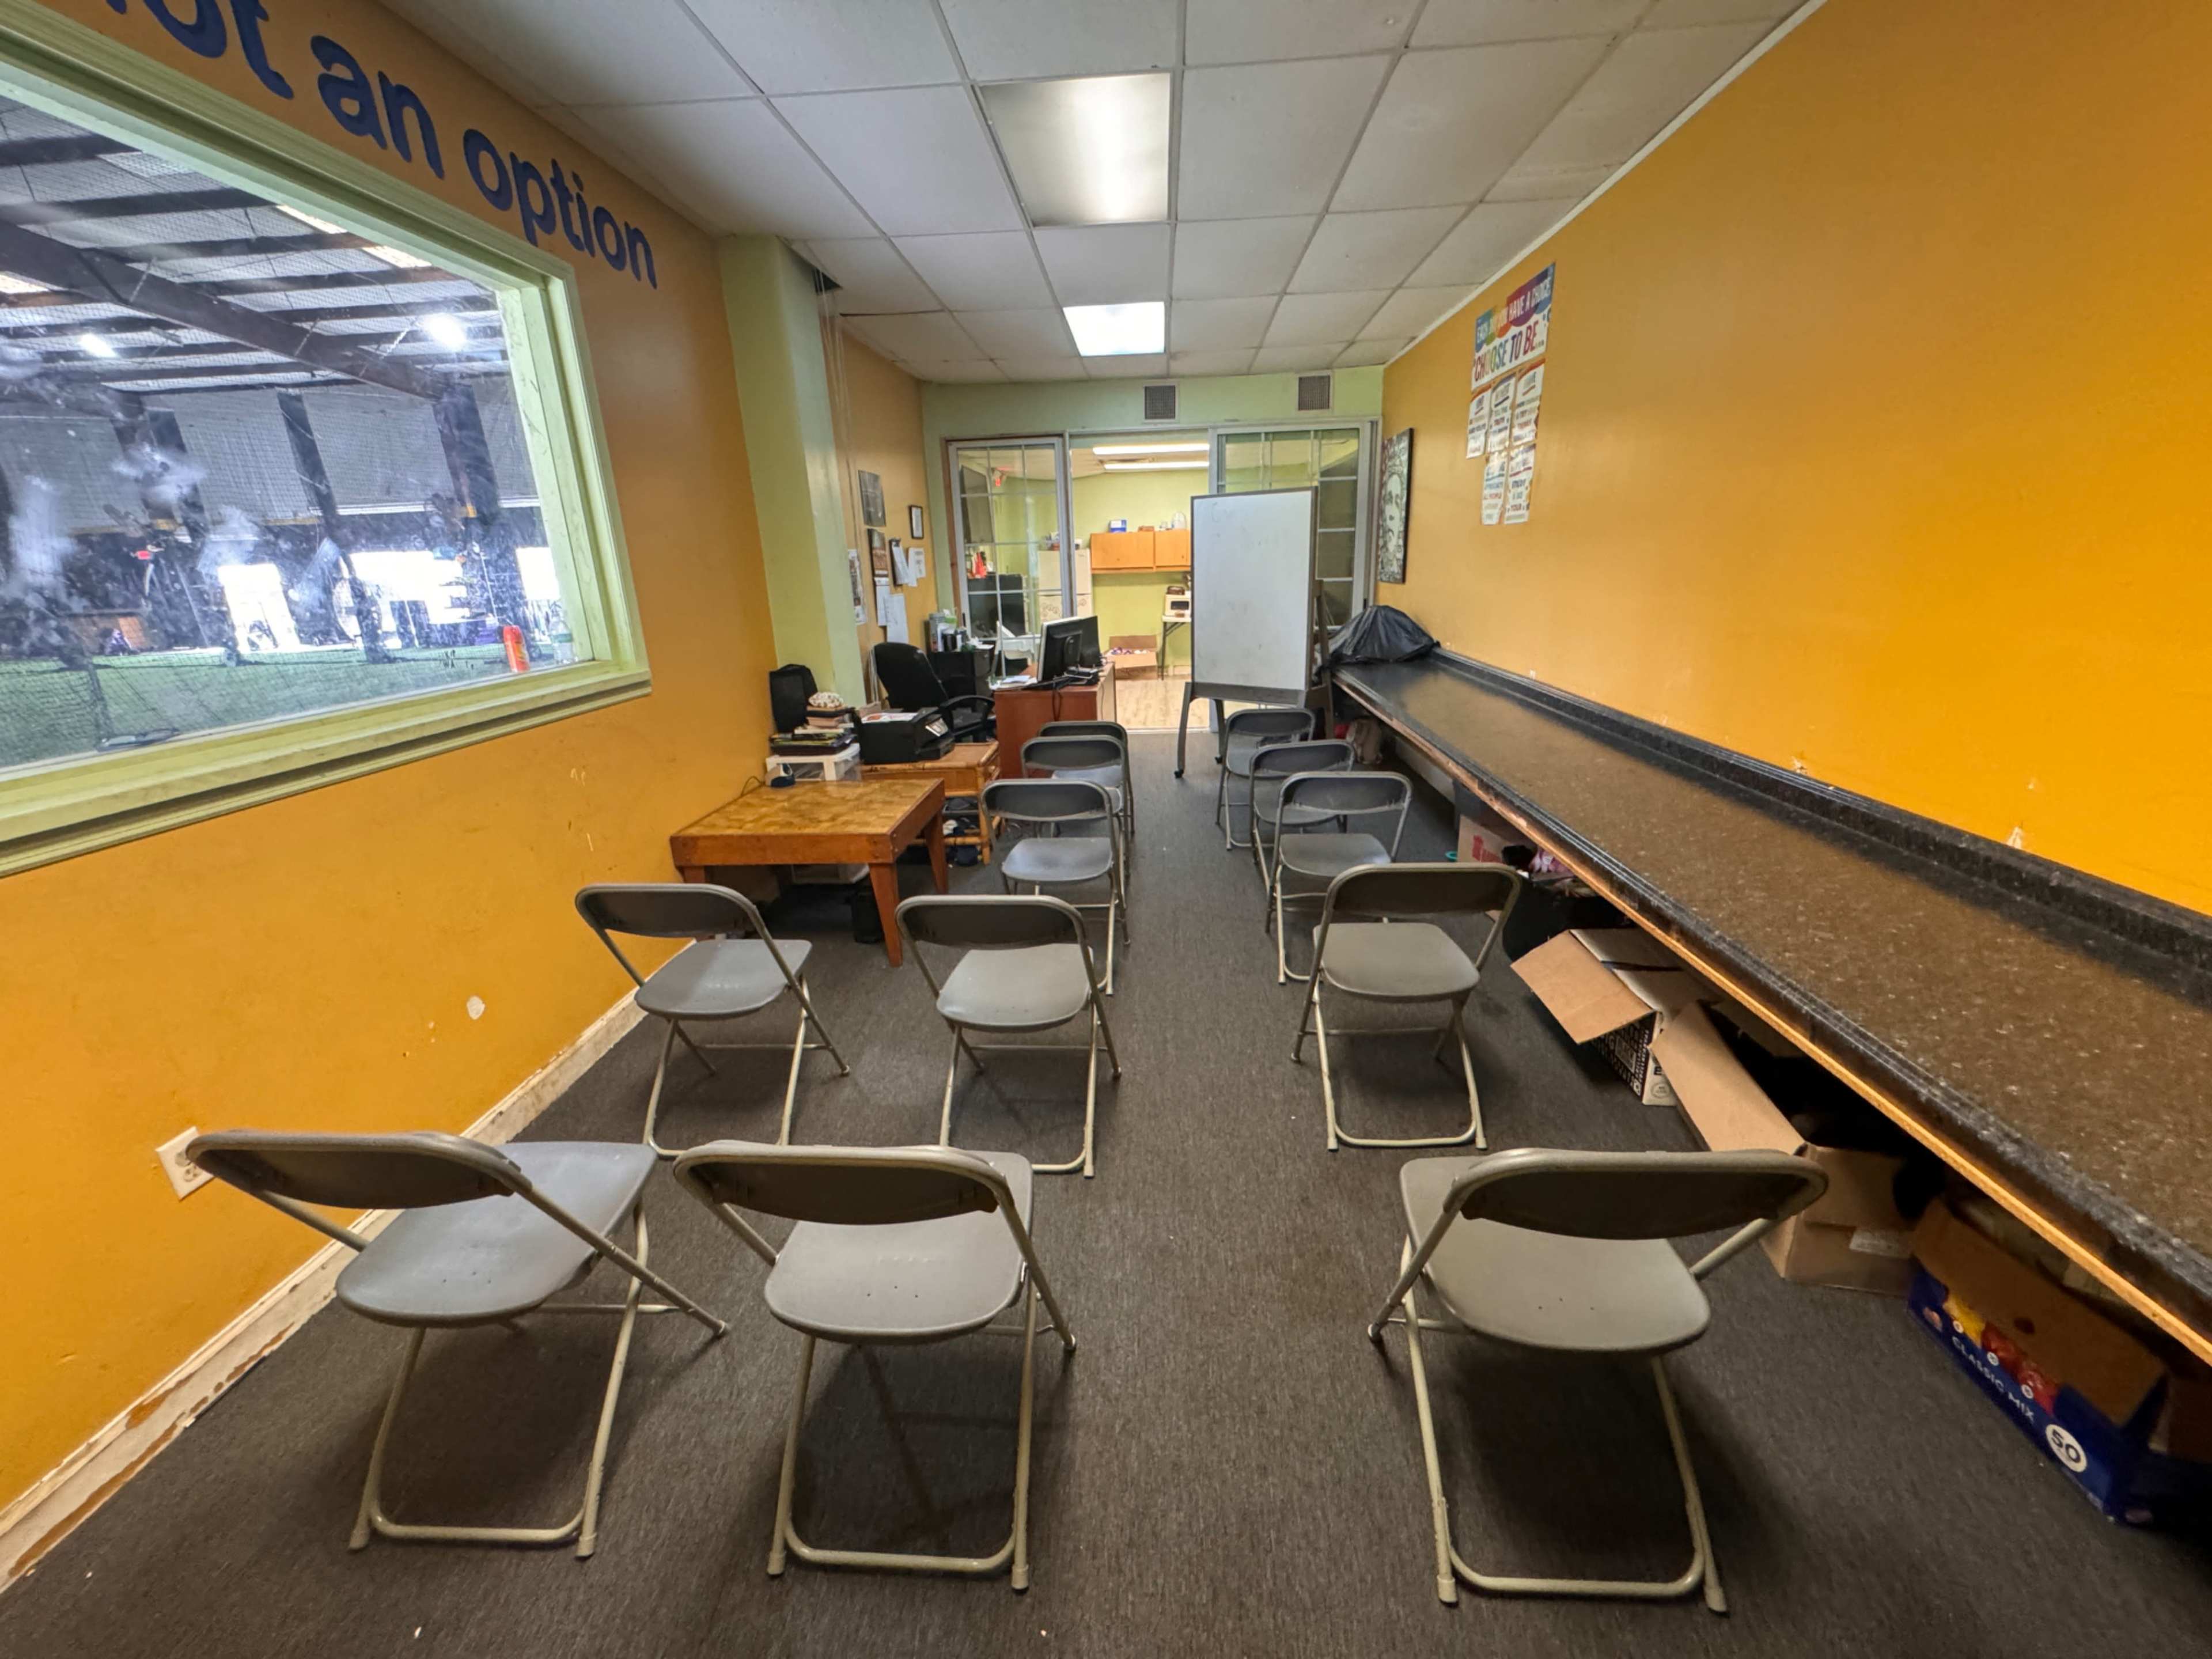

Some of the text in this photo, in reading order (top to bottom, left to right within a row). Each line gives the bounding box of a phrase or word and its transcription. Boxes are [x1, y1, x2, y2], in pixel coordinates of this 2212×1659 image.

[310, 35, 445, 180] an
[463, 128, 657, 290] option
[1509, 330, 1523, 363] TO
[1952, 1336, 2035, 1423] CLASSIC MIX
[2051, 1429, 2081, 1464] 50
